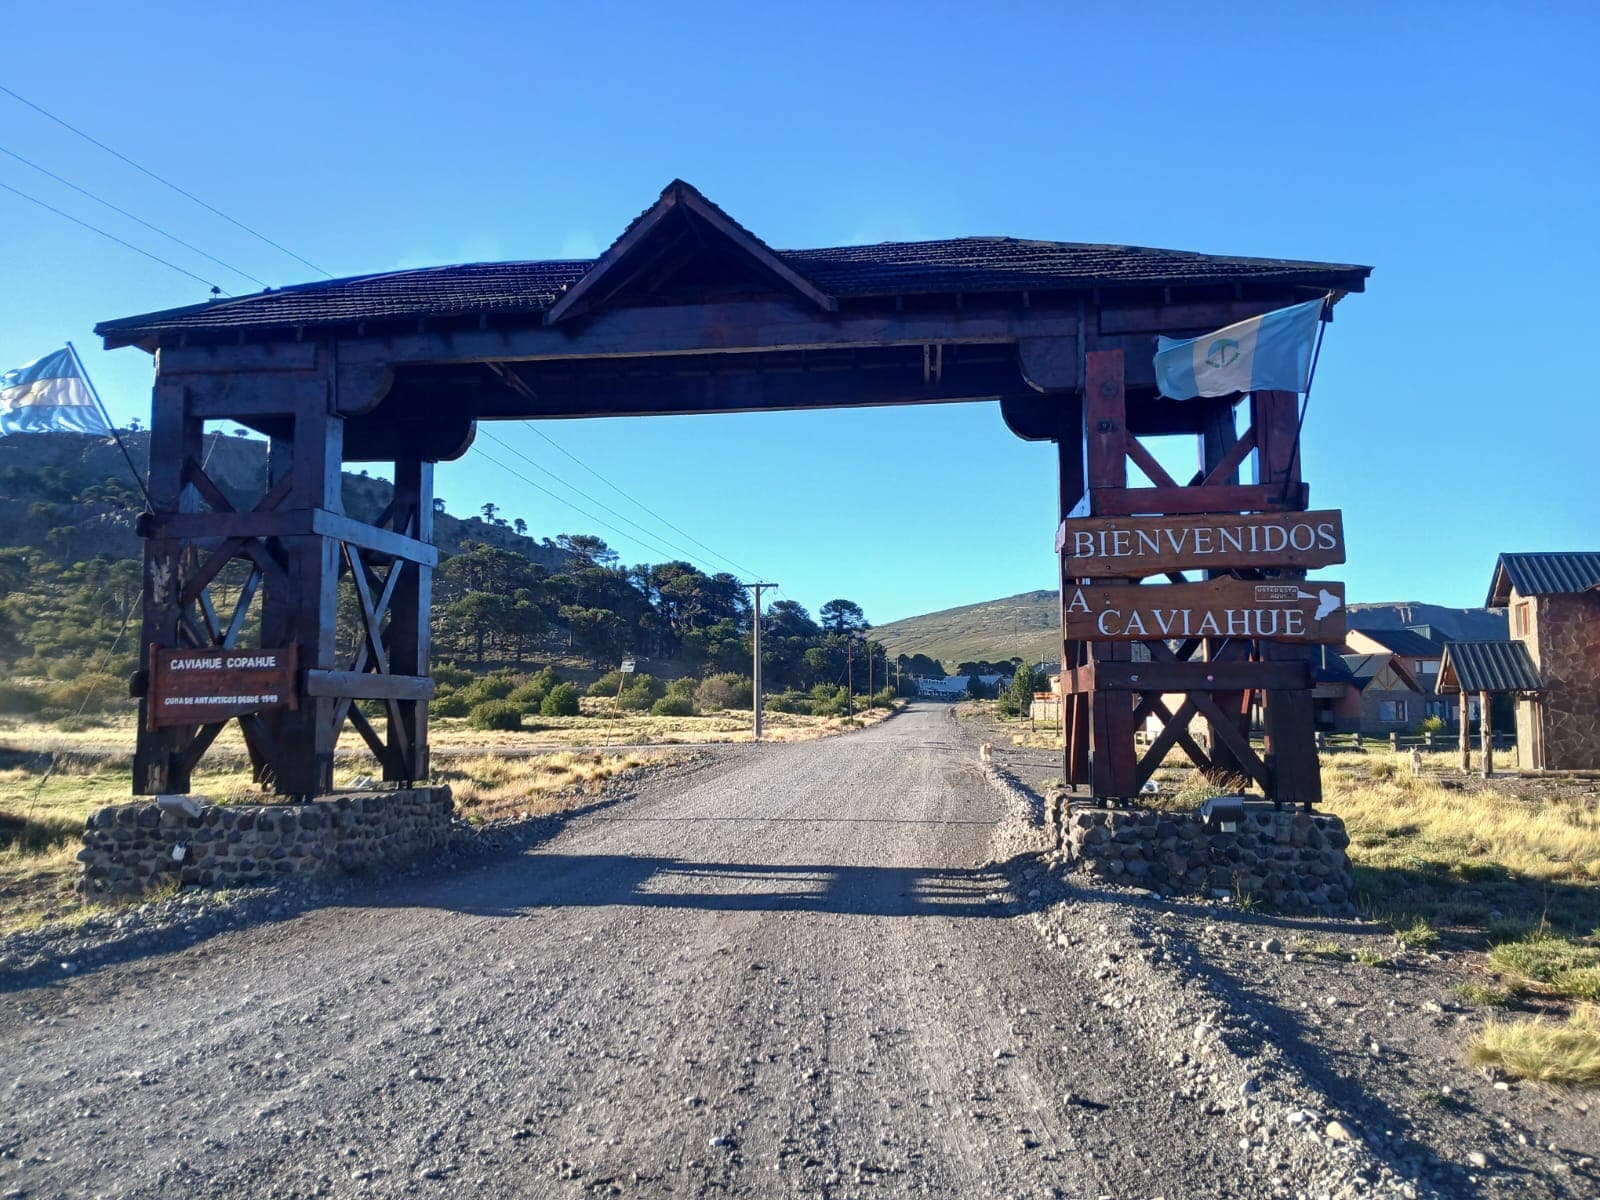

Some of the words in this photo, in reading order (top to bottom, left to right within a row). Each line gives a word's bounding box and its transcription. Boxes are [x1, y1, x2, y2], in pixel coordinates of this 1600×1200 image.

[1073, 523, 1337, 558] BIENVENIDOS
[1067, 588, 1092, 613] A
[1098, 609, 1306, 636] CAVIAHUE
[170, 658, 222, 670] CAVIAHUE
[227, 656, 276, 668] COPAHUE
[184, 697, 194, 705] DE
[238, 695, 259, 704] DESDE
